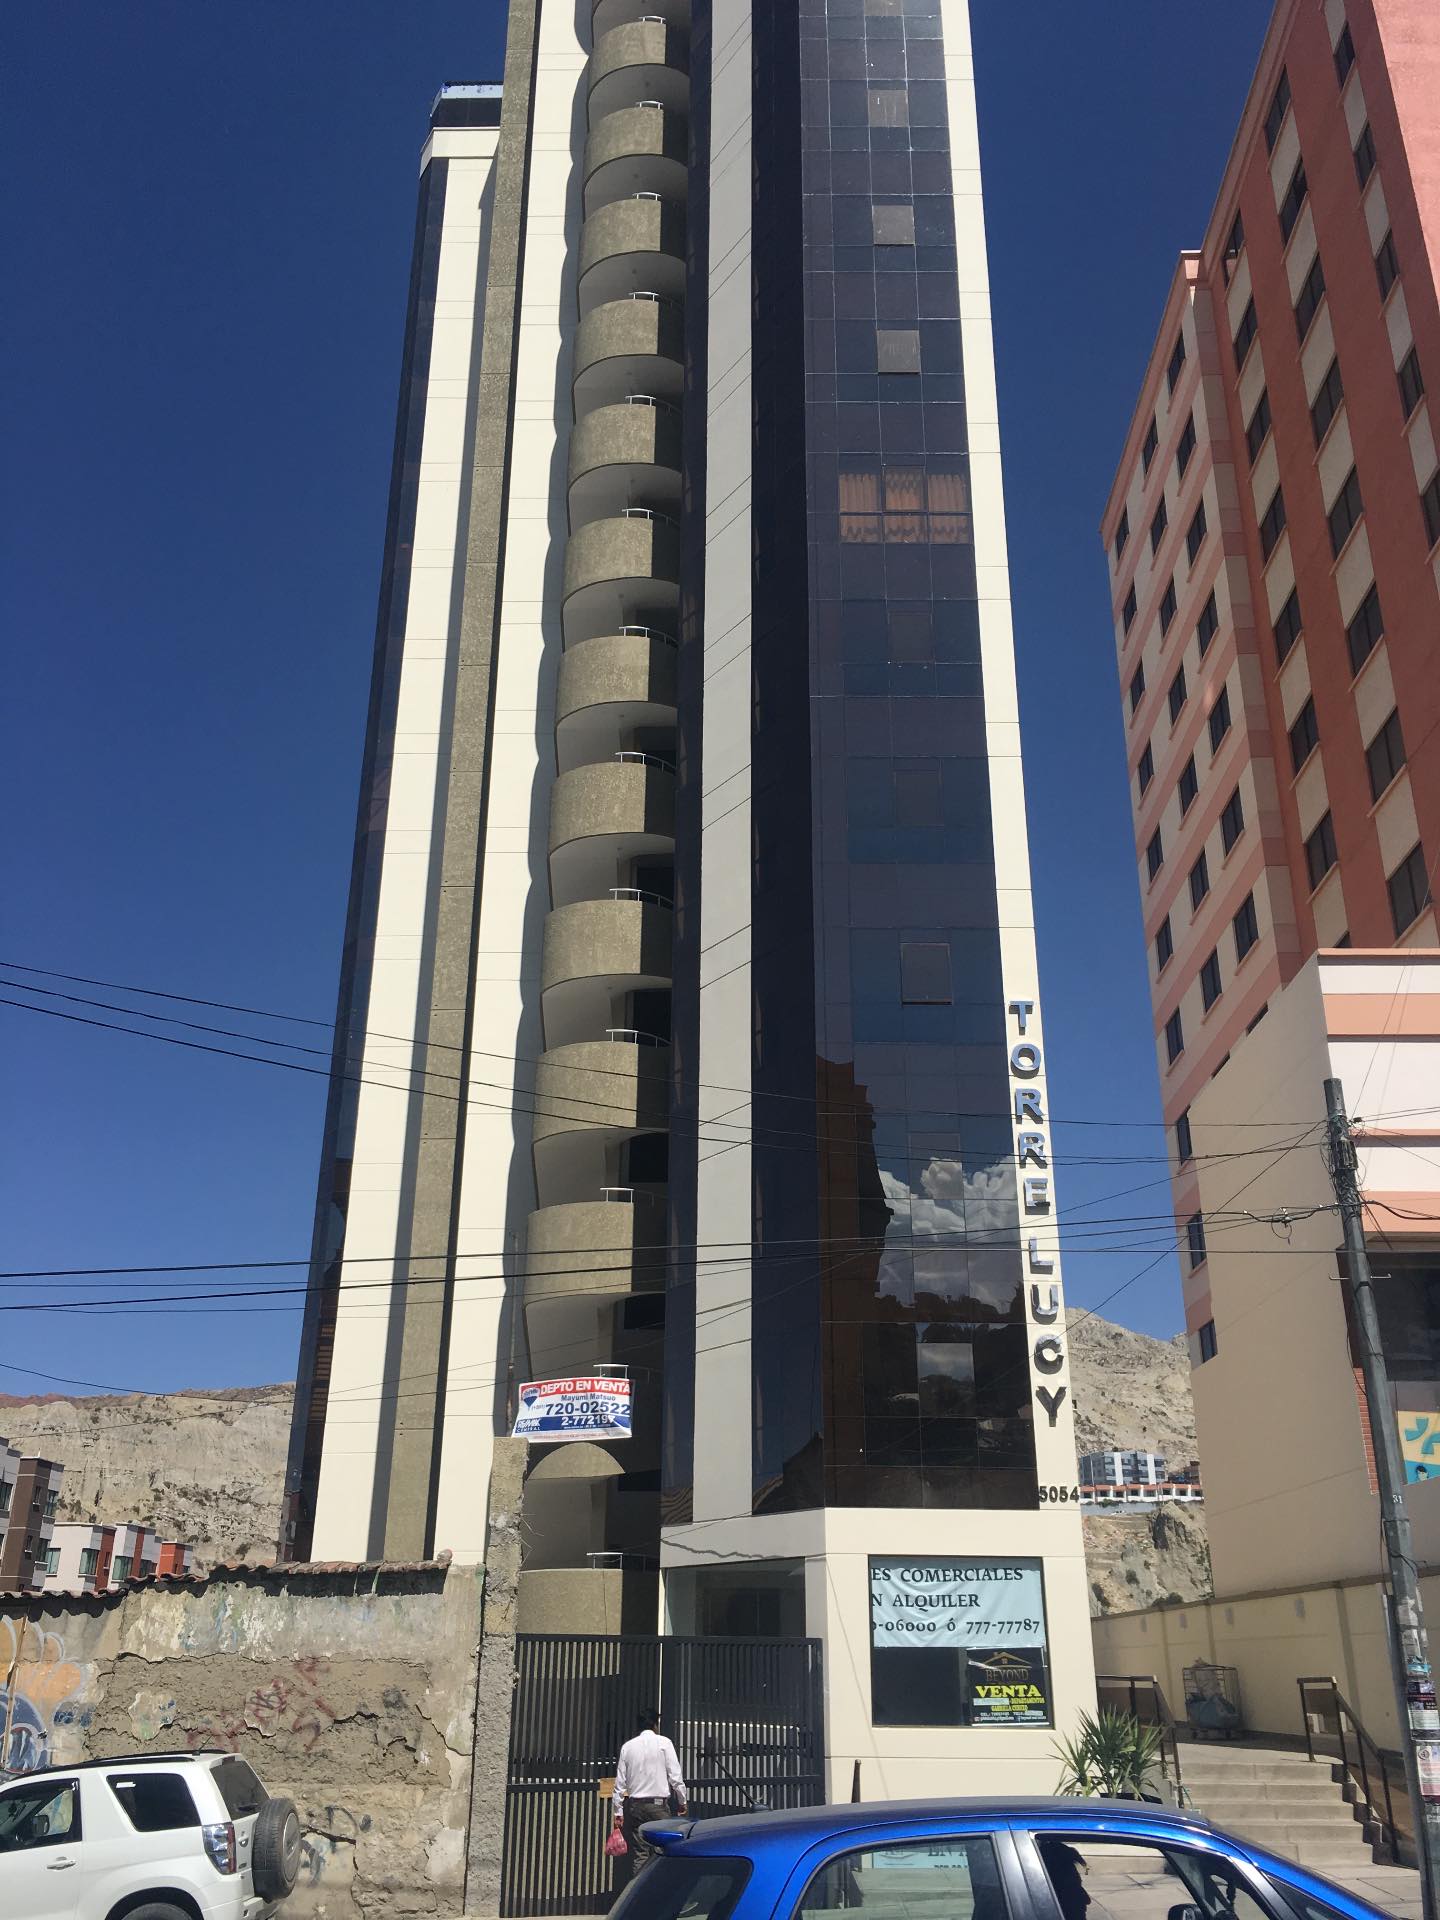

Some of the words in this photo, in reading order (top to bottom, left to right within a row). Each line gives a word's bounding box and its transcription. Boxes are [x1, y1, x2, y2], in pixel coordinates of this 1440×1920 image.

[1008, 1000, 1051, 1215] TORRE
[1028, 1236, 1067, 1428] LUCY
[541, 1382, 573, 1394] DEPTO
[575, 1381, 591, 1391] EN
[594, 1380, 631, 1393] VENTA
[561, 1394, 588, 1403] Mayumi
[545, 1401, 630, 1416] 720-02522
[1039, 1486, 1079, 1503] 5054
[900, 1567, 1023, 1583] COMERCIALES
[893, 1594, 981, 1612] ALQUILER
[947, 1618, 956, 1632] ó
[966, 1618, 1040, 1634] 777-77787
[985, 1668, 1029, 1681] BEYOND
[975, 1685, 1042, 1697] VENTA
